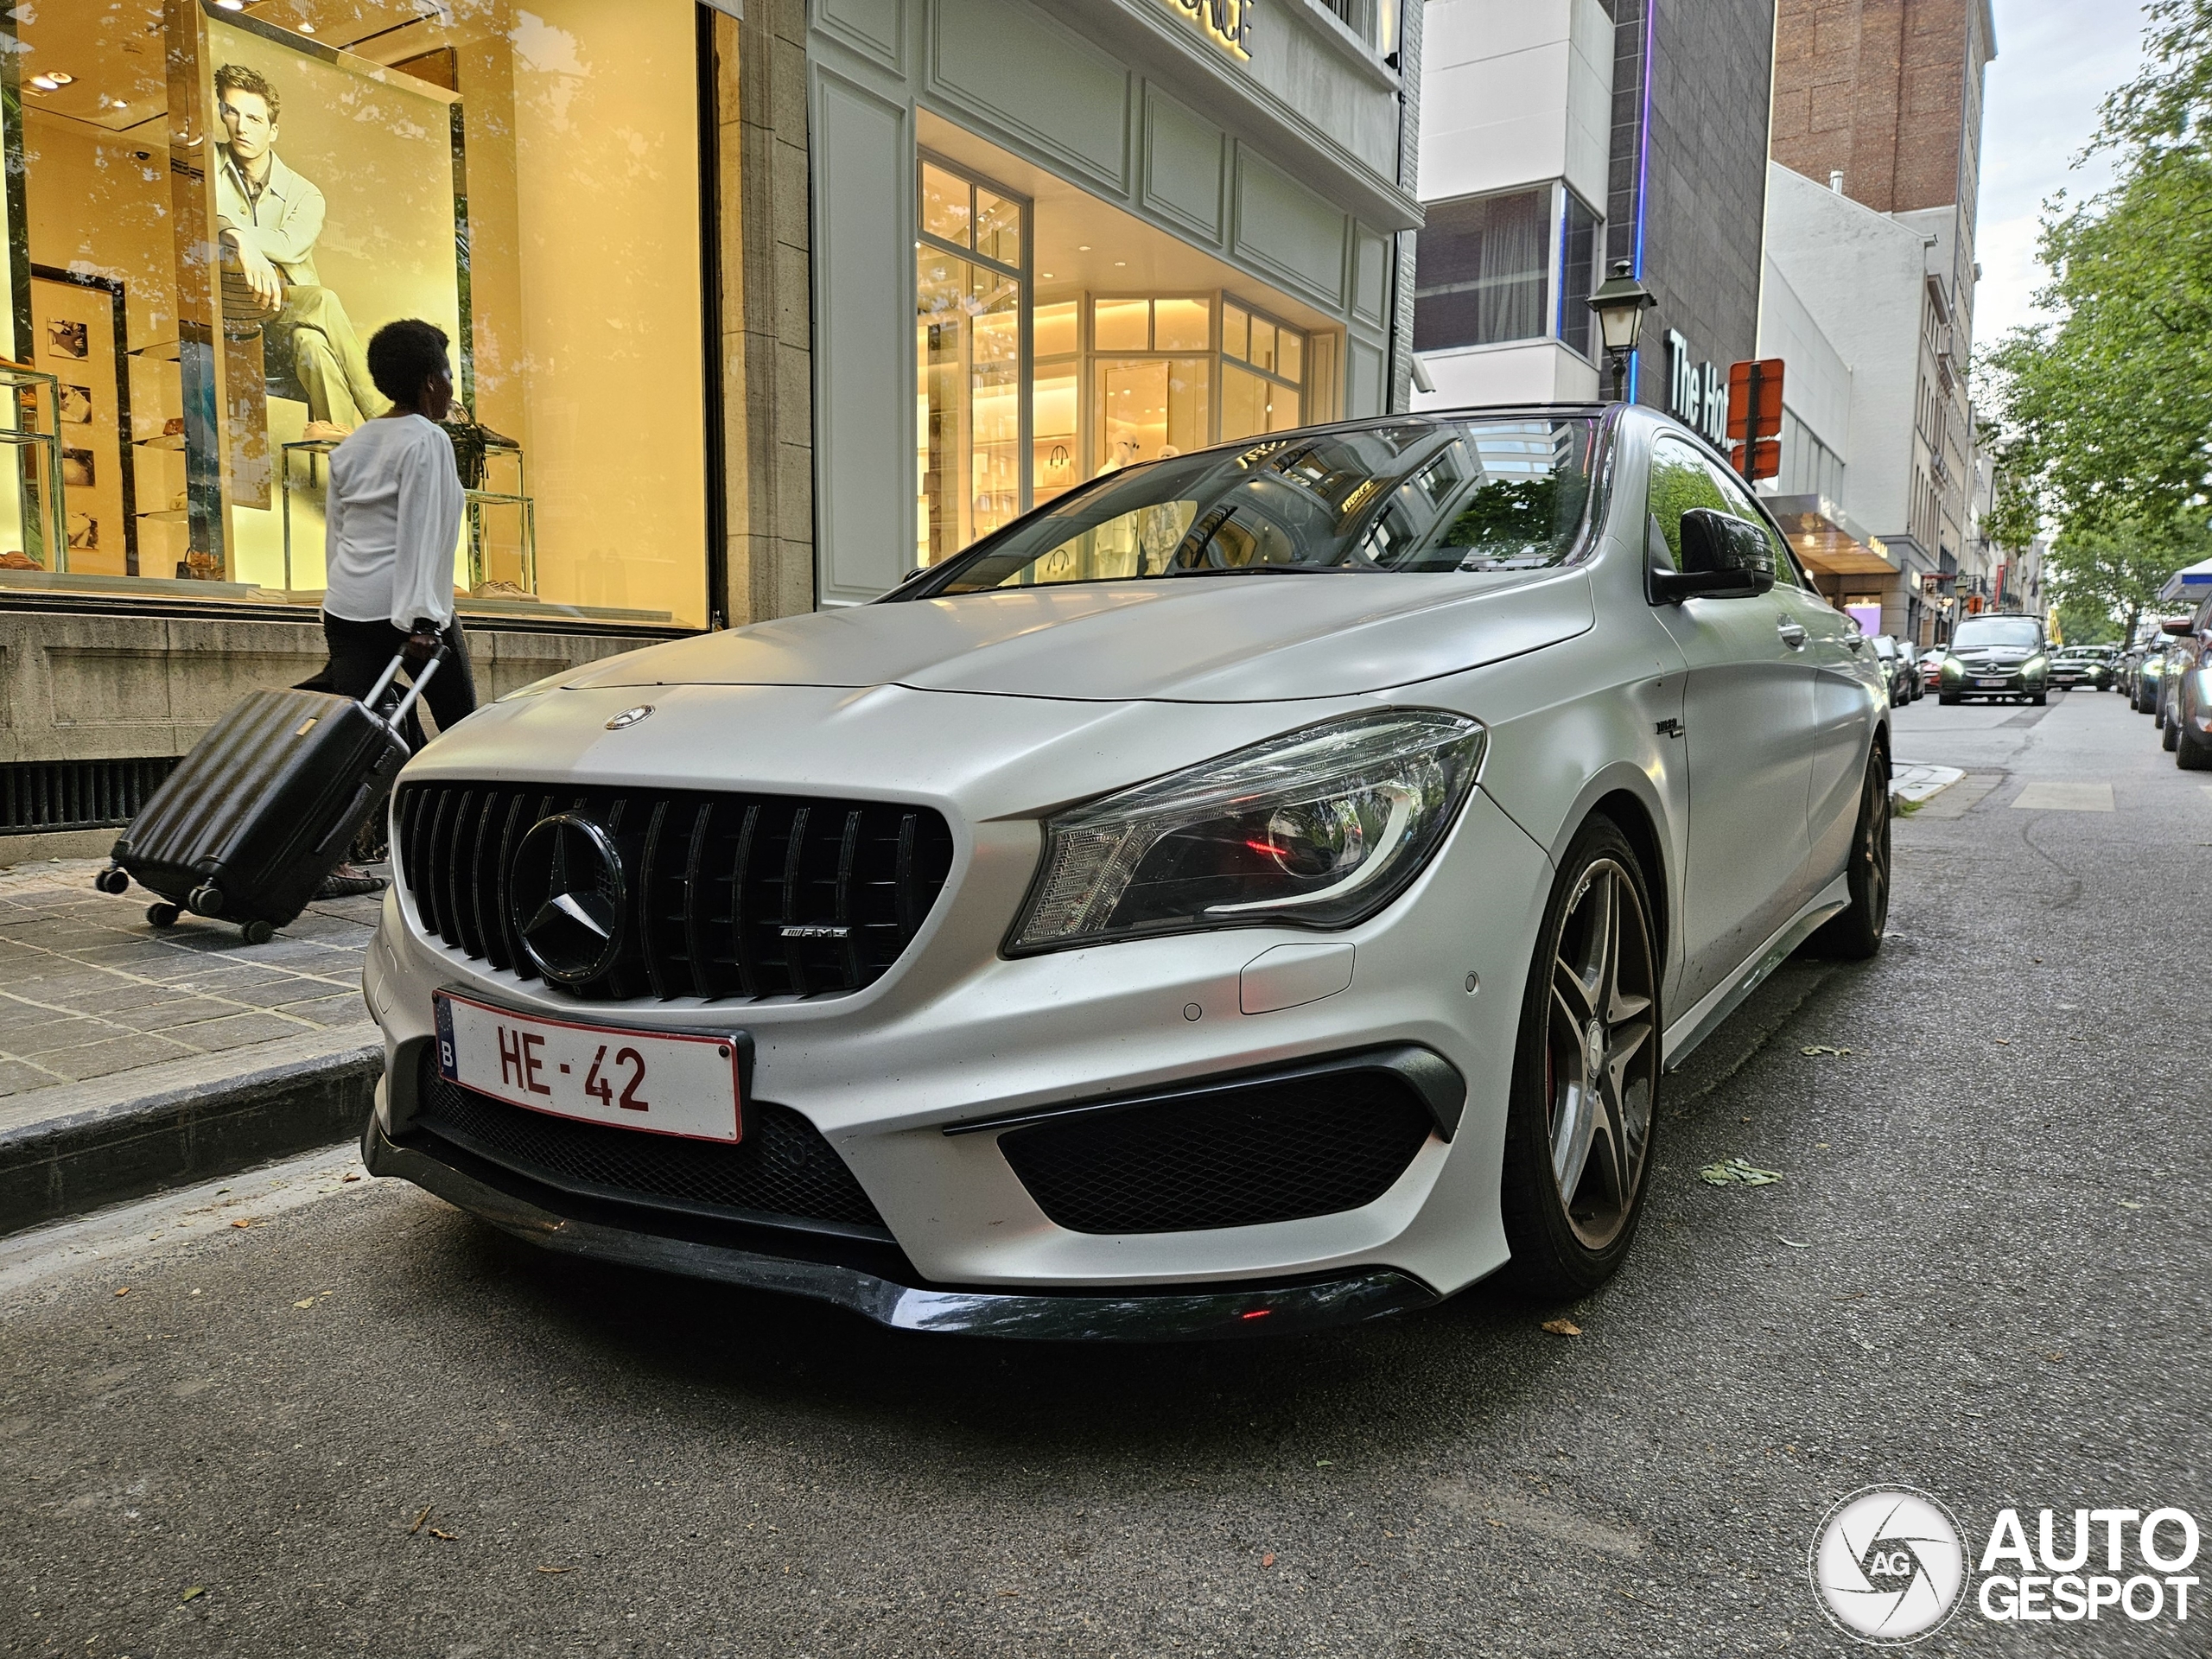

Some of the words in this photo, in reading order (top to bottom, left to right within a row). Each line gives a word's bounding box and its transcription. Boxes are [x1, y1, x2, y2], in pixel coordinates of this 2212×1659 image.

[1668, 327, 1700, 426] The
[1703, 360, 1736, 452] Hot
[798, 928, 848, 938] AMG
[442, 1040, 453, 1067] B
[498, 1027, 649, 1112] HE-42
